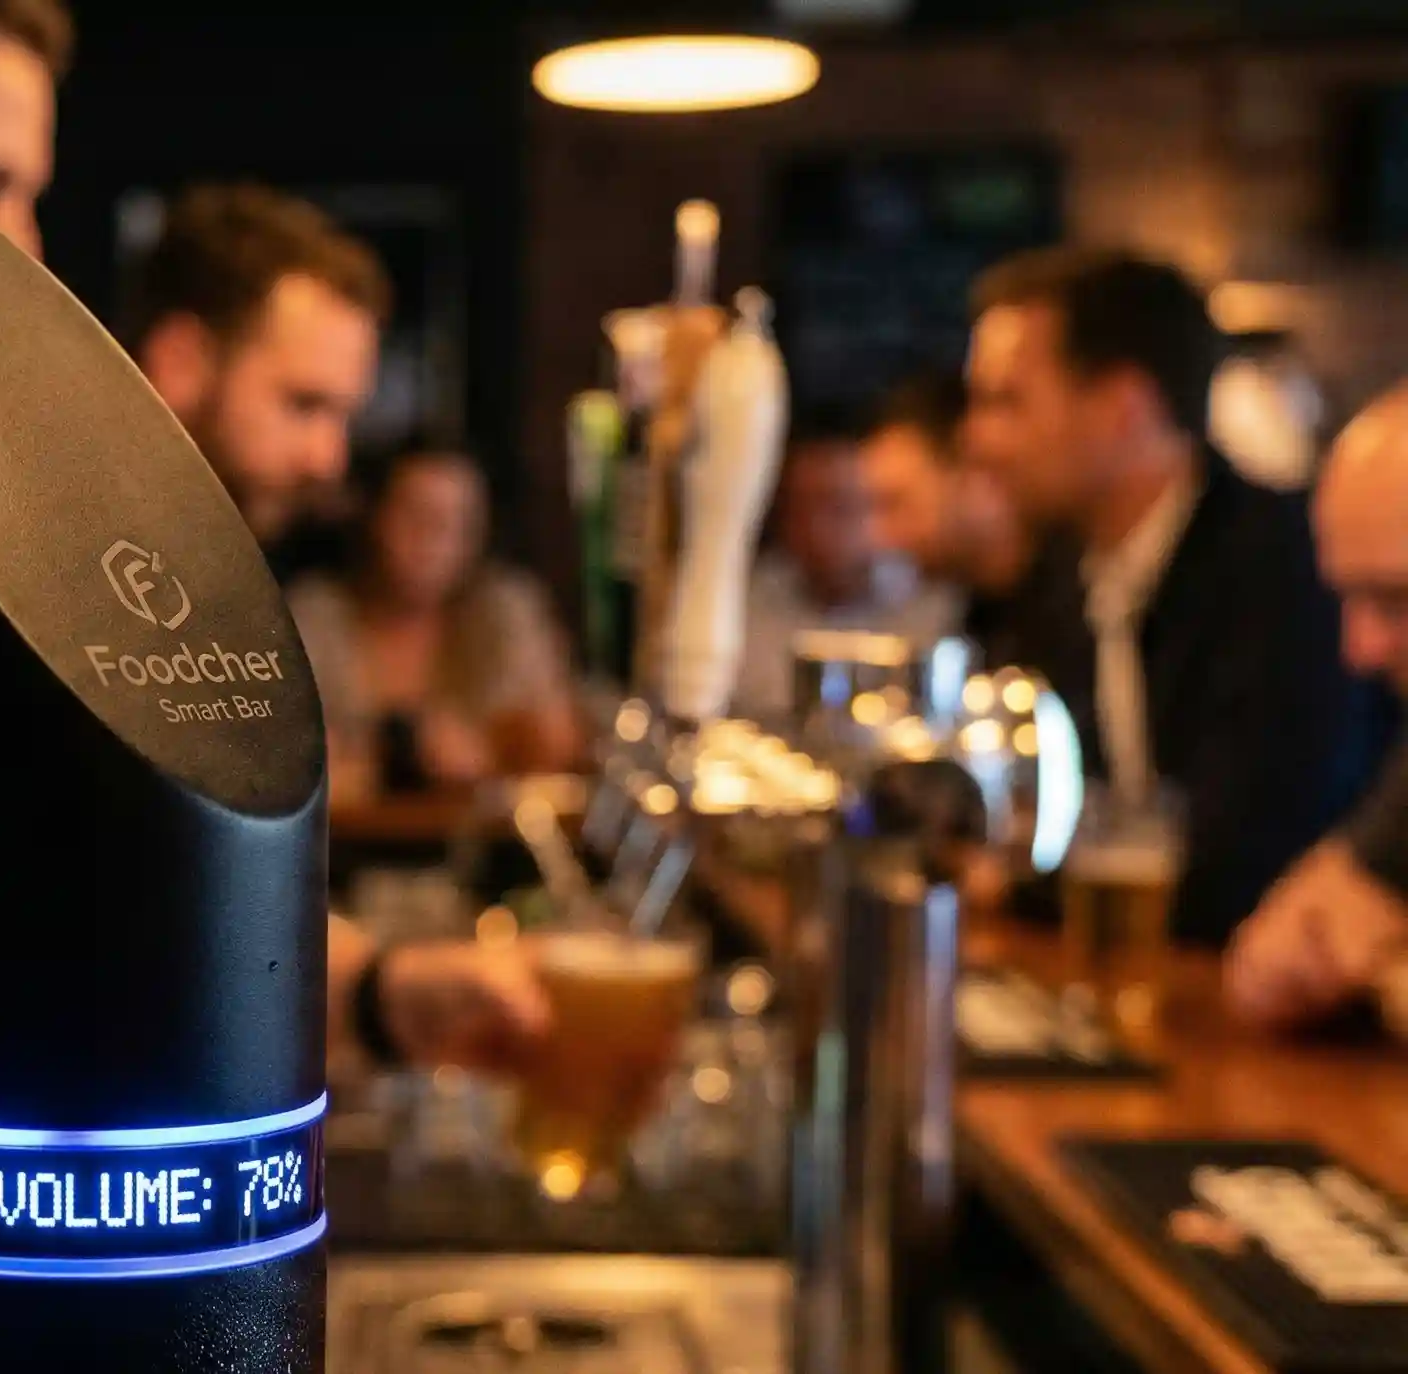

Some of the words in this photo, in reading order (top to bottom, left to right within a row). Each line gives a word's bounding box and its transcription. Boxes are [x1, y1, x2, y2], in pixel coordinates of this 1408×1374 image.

[83, 642, 284, 688] Foodcher
[158, 698, 233, 723] Smart
[232, 695, 273, 719] Bar
[238, 1150, 303, 1217] 78%
